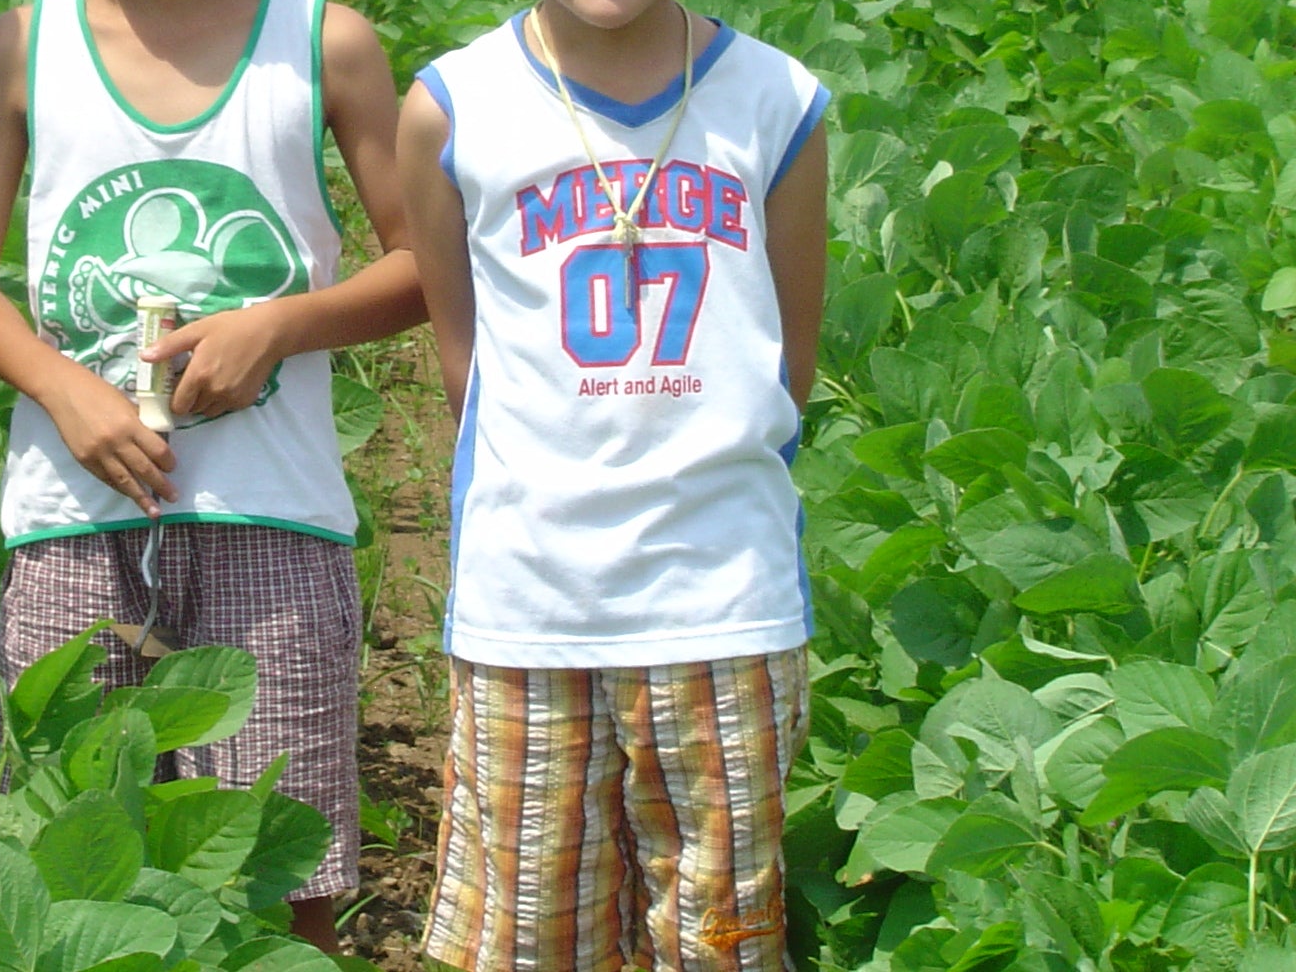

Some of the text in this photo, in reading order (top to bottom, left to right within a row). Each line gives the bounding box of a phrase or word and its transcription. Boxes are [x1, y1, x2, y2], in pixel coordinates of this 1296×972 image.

[42, 169, 145, 353] STERIC MINI
[516, 158, 748, 257] MERGE
[559, 241, 711, 368] 07
[577, 375, 702, 398] Alert and Agile
